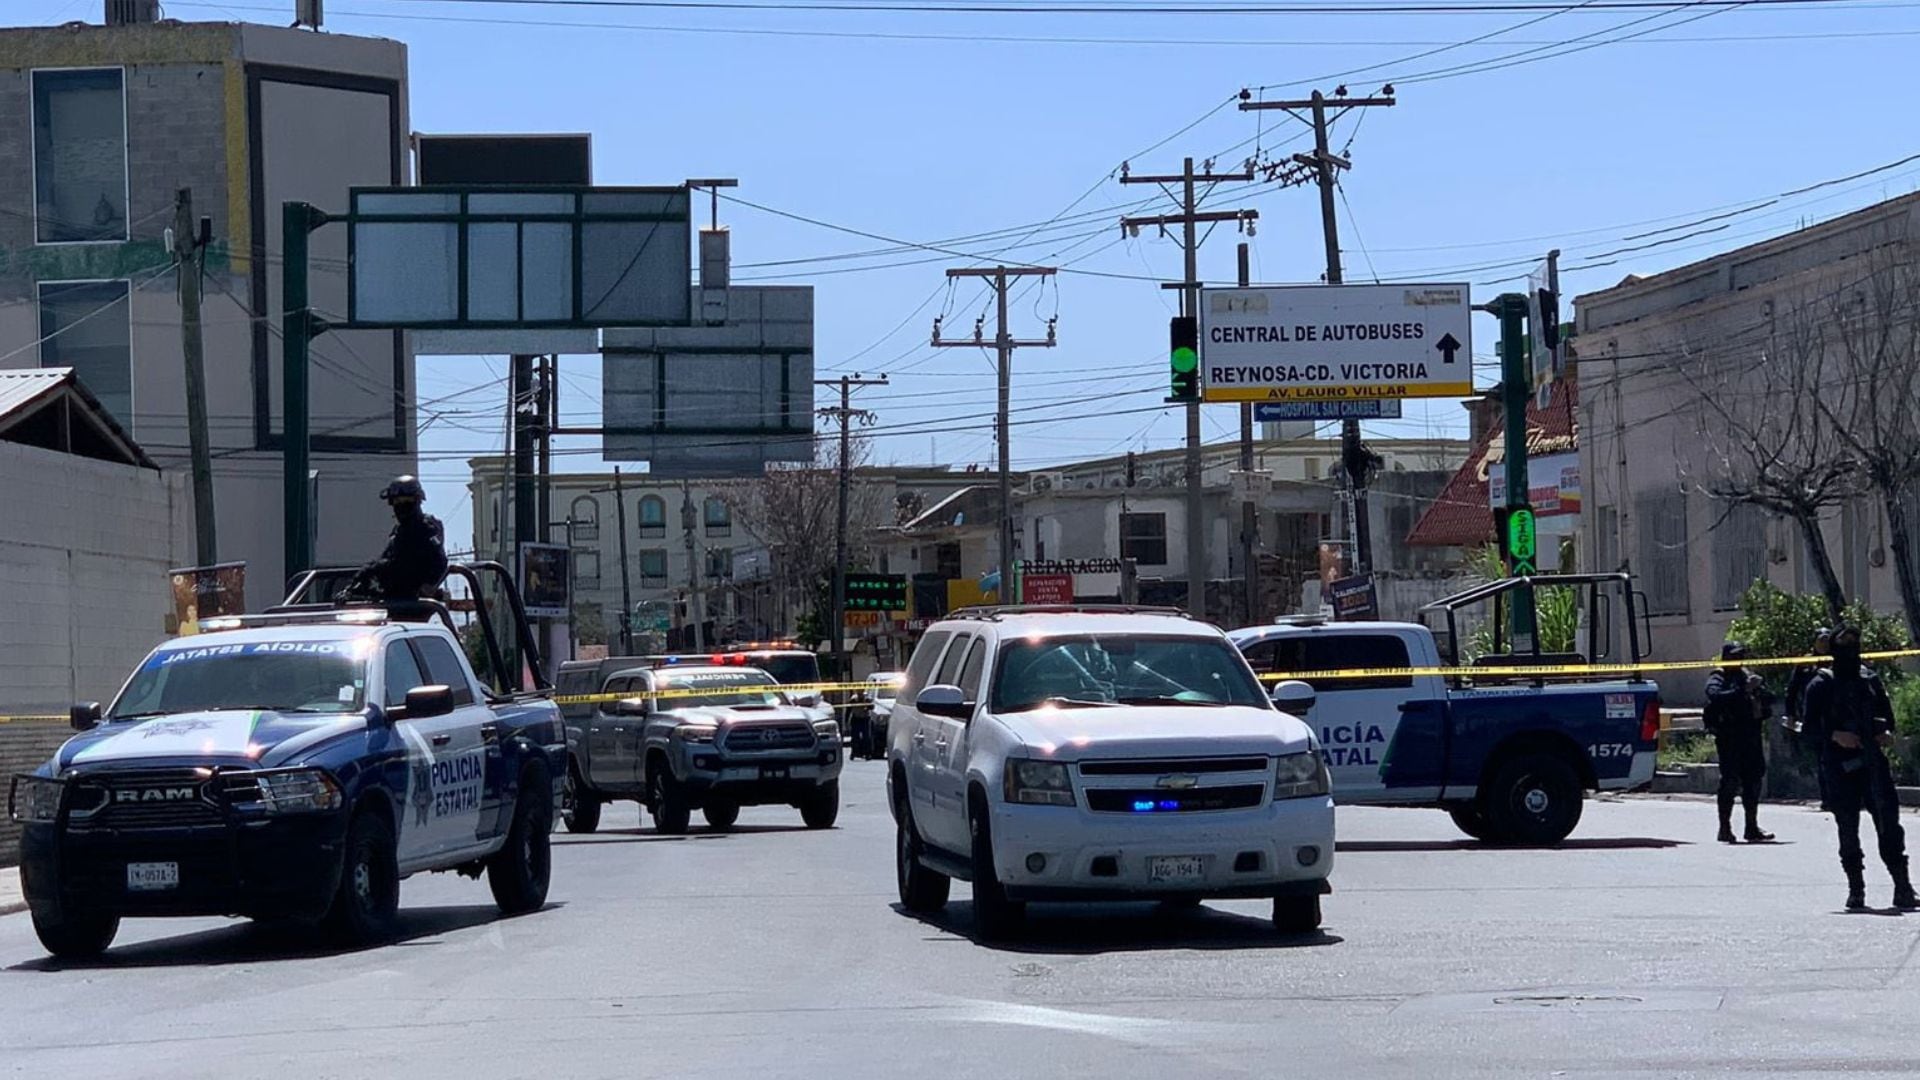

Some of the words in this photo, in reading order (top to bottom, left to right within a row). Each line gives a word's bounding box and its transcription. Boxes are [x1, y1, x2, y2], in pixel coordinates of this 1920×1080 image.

[1210, 326, 1289, 343] CENTRAL
[1295, 325, 1316, 342] DE
[1322, 323, 1424, 341] AUTOBUSES
[1211, 365, 1334, 383] REYNOSA-CD.
[1340, 363, 1428, 380] VICTORIA
[1296, 387, 1347, 397] LAURO
[1353, 385, 1407, 396] VILLAR
[1280, 402, 1319, 417] HOSPITAL
[1322, 402, 1340, 416] SAN
[1517, 511, 1530, 556] SIGA
[1022, 559, 1121, 575] REPARACION
[1587, 743, 1633, 758] 1574
[116, 788, 194, 802] RAM
[436, 785, 479, 817] ESTATAL
